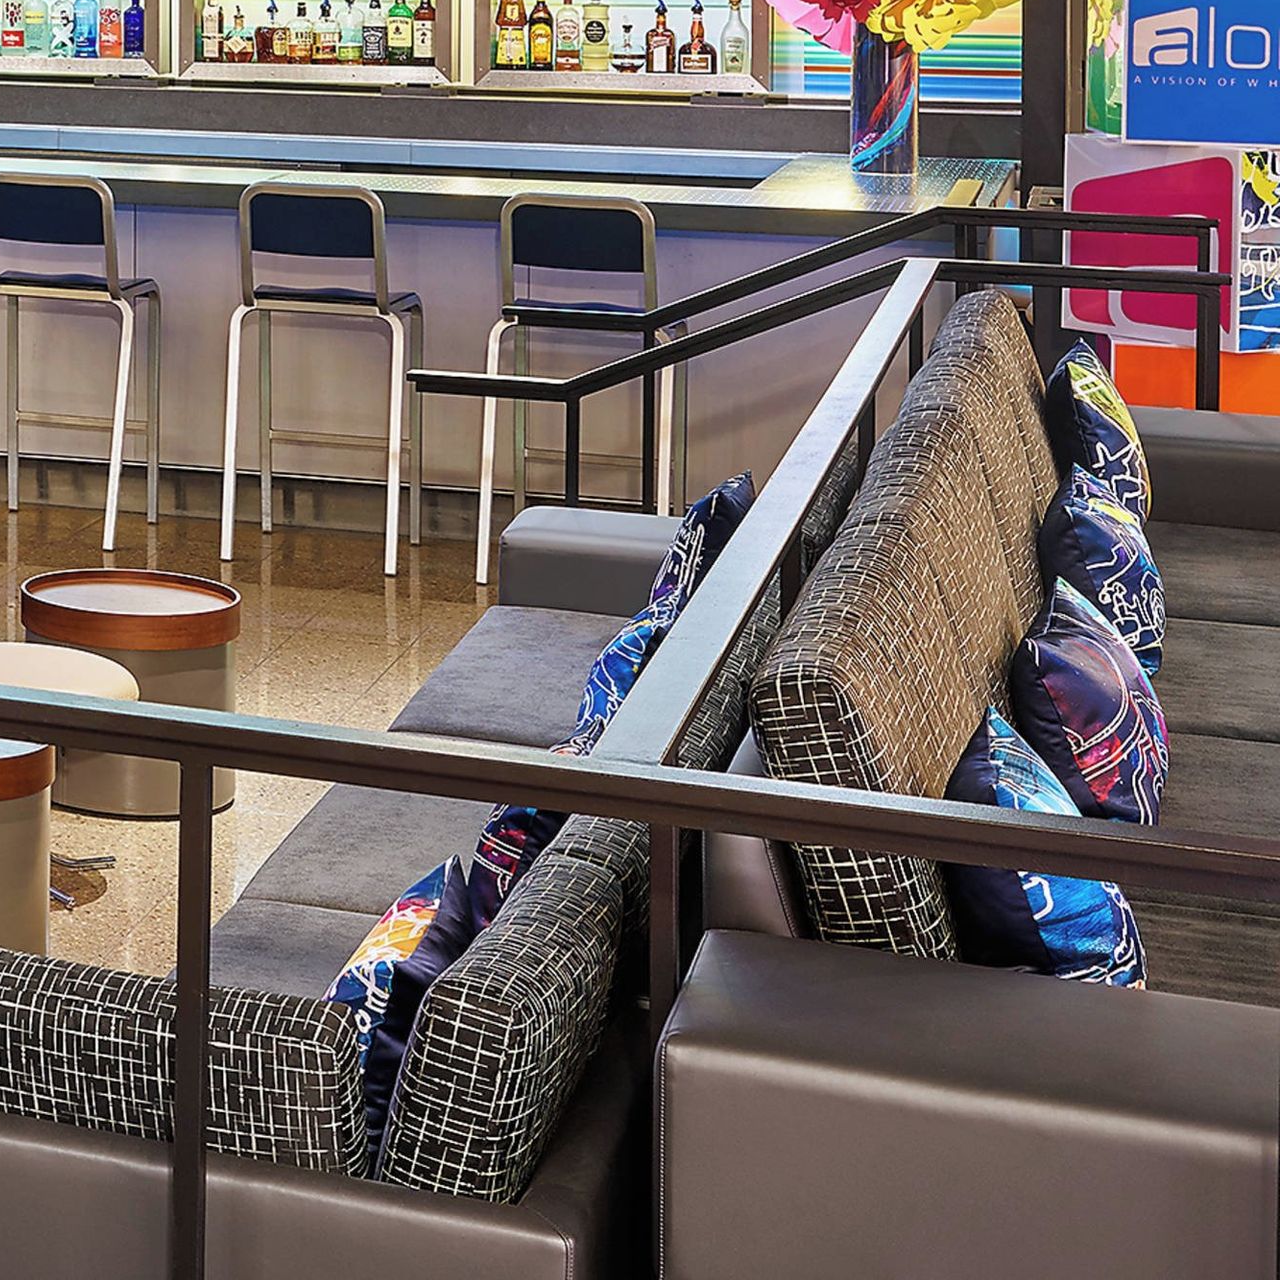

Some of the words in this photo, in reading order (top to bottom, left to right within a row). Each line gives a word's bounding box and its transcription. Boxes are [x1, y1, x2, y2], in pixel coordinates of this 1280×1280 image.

[1132, 6, 1280, 70] alo
[1133, 74, 1142, 85] A
[1150, 75, 1207, 87] VISION
[1217, 77, 1238, 88] OF
[1246, 78, 1259, 88] W
